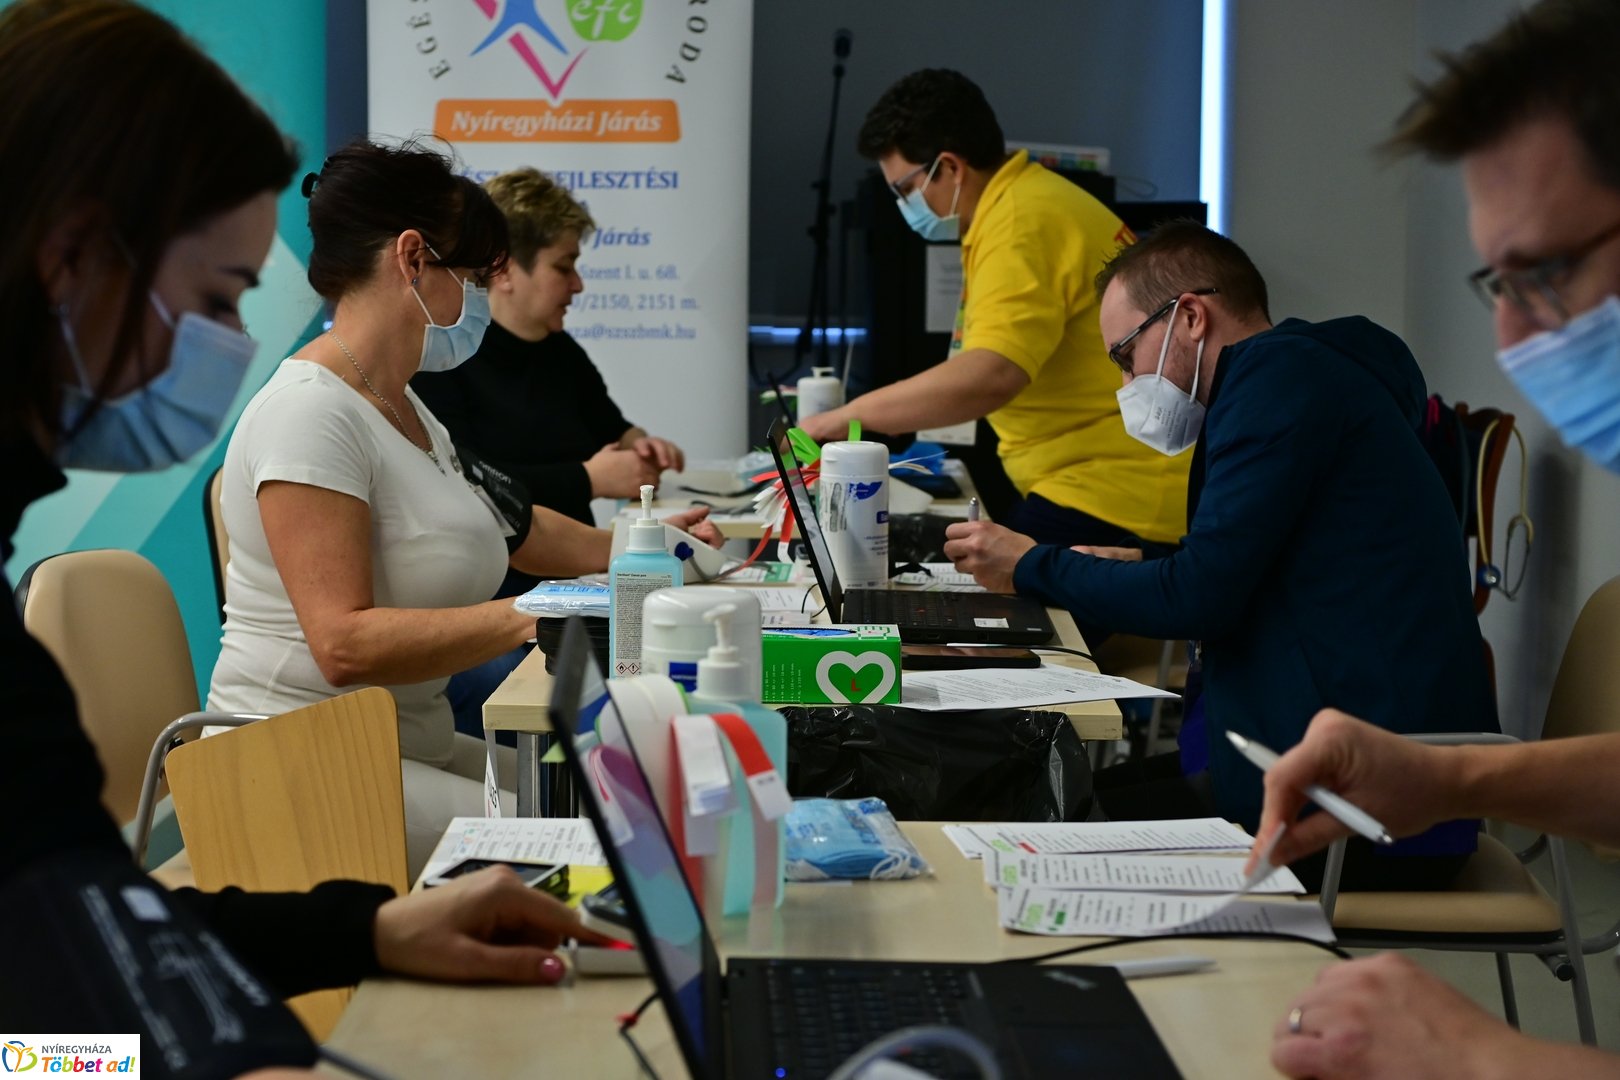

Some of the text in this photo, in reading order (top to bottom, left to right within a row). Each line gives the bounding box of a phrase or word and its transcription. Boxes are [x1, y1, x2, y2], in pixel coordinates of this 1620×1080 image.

[664, 0, 709, 83] ODA
[451, 110, 662, 137] Nyíregyházi Járás
[592, 227, 652, 249] Járás
[636, 293, 676, 310] 2151
